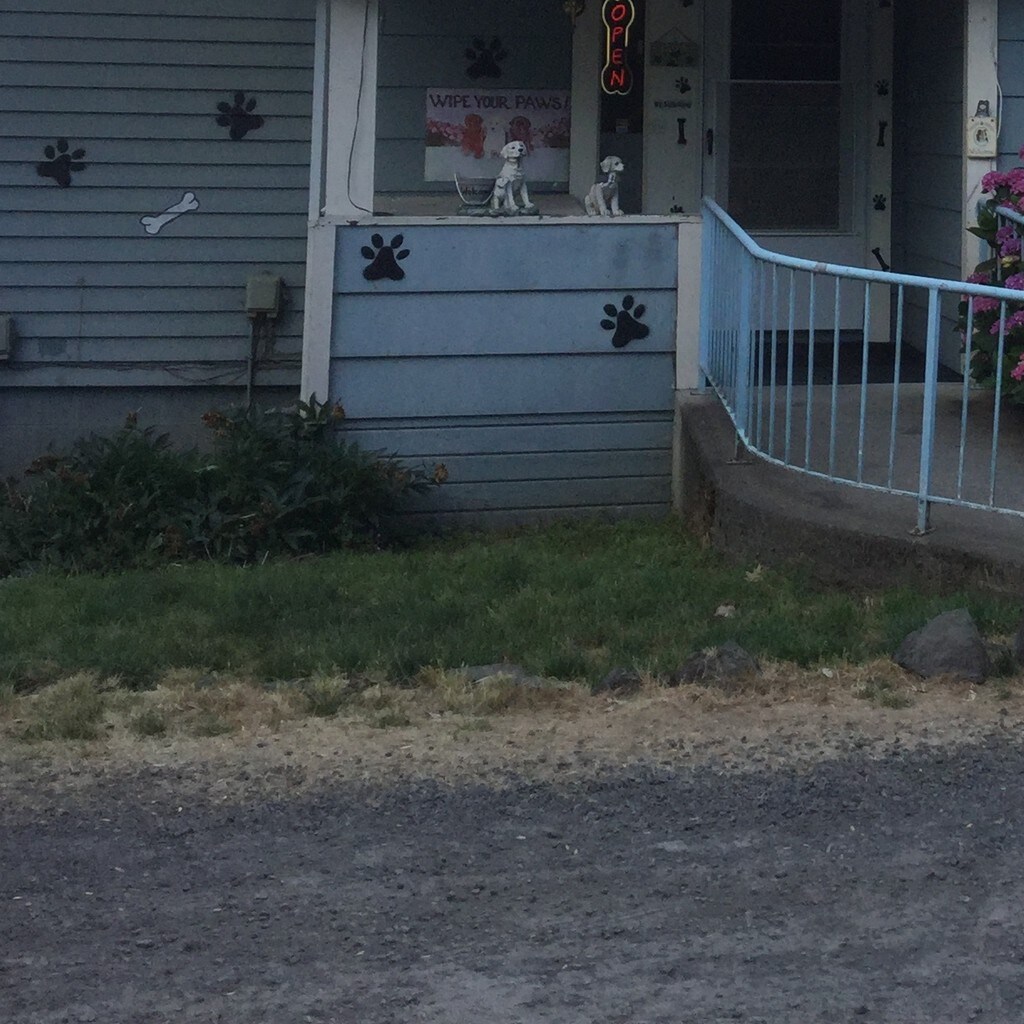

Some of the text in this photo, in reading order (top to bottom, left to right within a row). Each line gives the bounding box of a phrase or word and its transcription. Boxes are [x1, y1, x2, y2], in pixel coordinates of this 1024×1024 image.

[611, 3, 627, 86] OPEN
[429, 94, 472, 109] WIPE
[474, 94, 511, 110] YOUR
